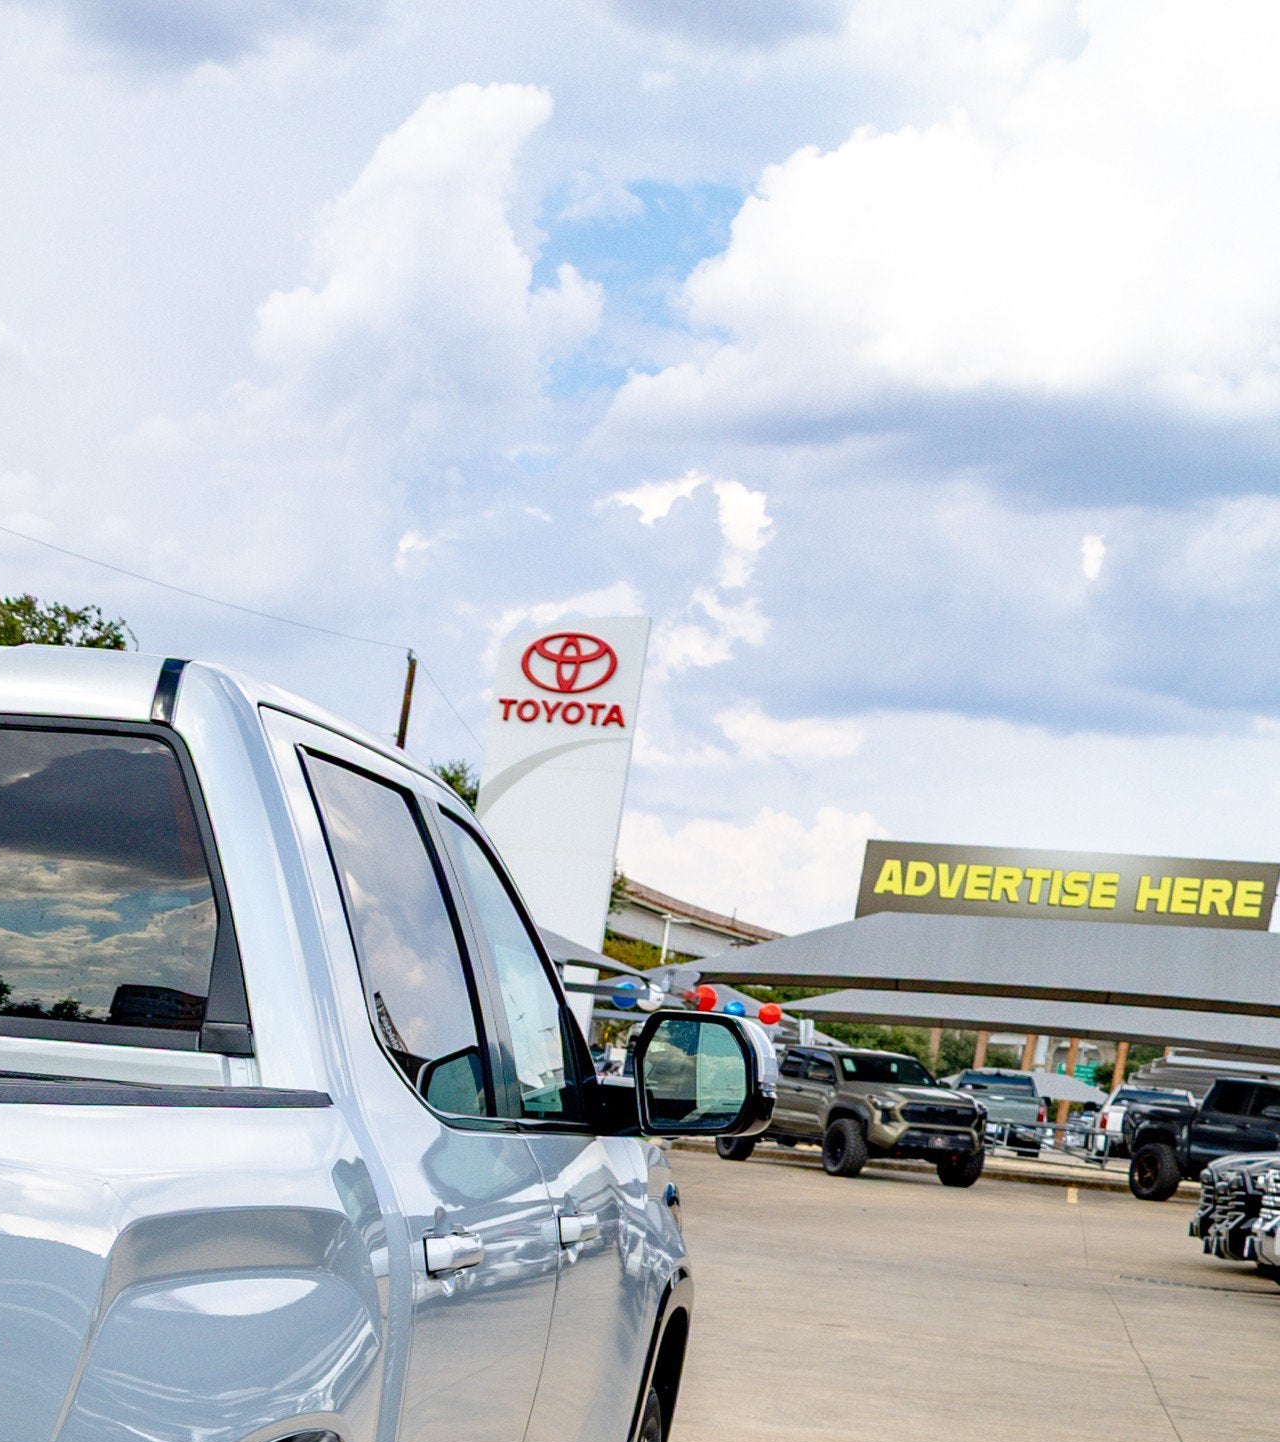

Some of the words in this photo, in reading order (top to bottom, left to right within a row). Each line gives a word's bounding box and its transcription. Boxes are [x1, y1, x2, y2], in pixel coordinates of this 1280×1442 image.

[499, 698, 625, 727] TOYOTA
[874, 859, 1119, 909] ADVERTISE
[1135, 876, 1265, 918] HERE
